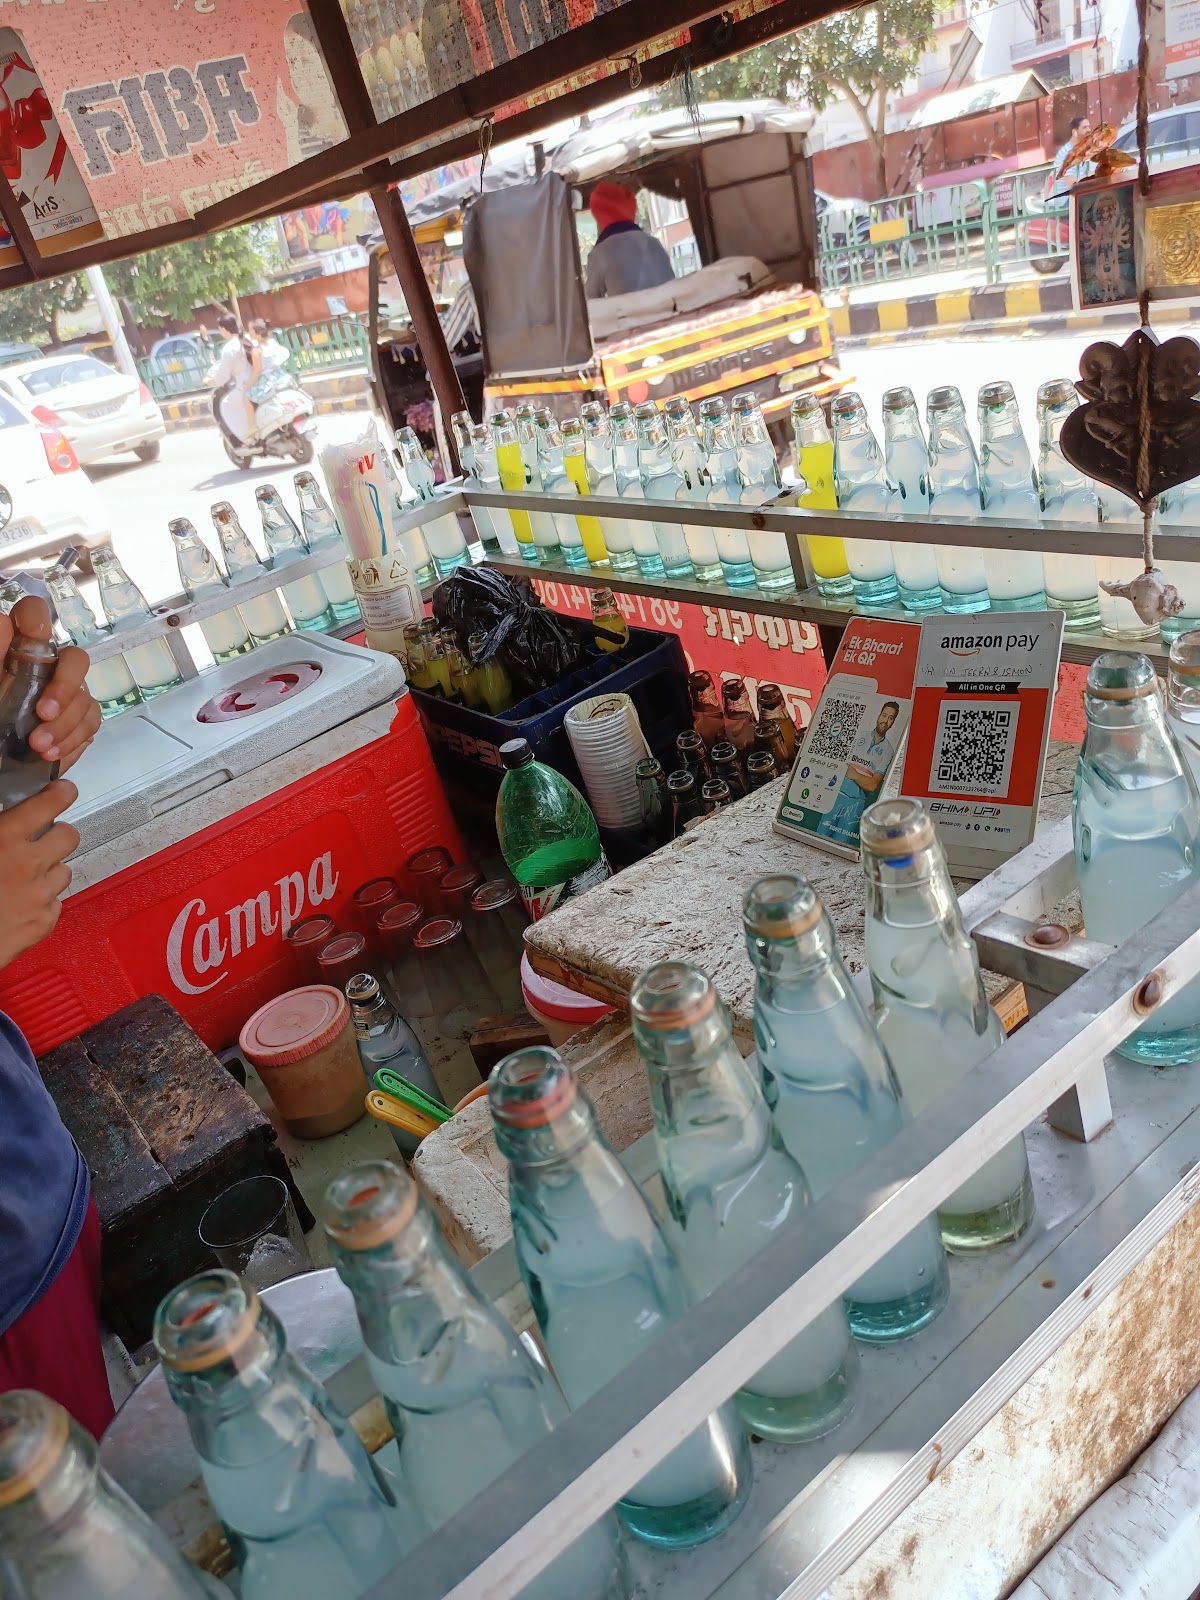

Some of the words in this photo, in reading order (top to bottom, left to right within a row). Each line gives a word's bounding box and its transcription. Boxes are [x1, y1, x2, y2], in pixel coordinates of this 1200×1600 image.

[849, 635, 862, 649] Ek
[863, 636, 904, 655] Bharat
[941, 634, 1003, 649] amazon
[1006, 633, 1040, 651] pay
[843, 650, 856, 663] Ek
[858, 651, 877, 666] QR
[958, 683, 969, 691] All
[978, 684, 994, 692] One
[929, 802, 965, 814] BHIM
[973, 806, 997, 817] UPI
[165, 850, 340, 996] Campa
